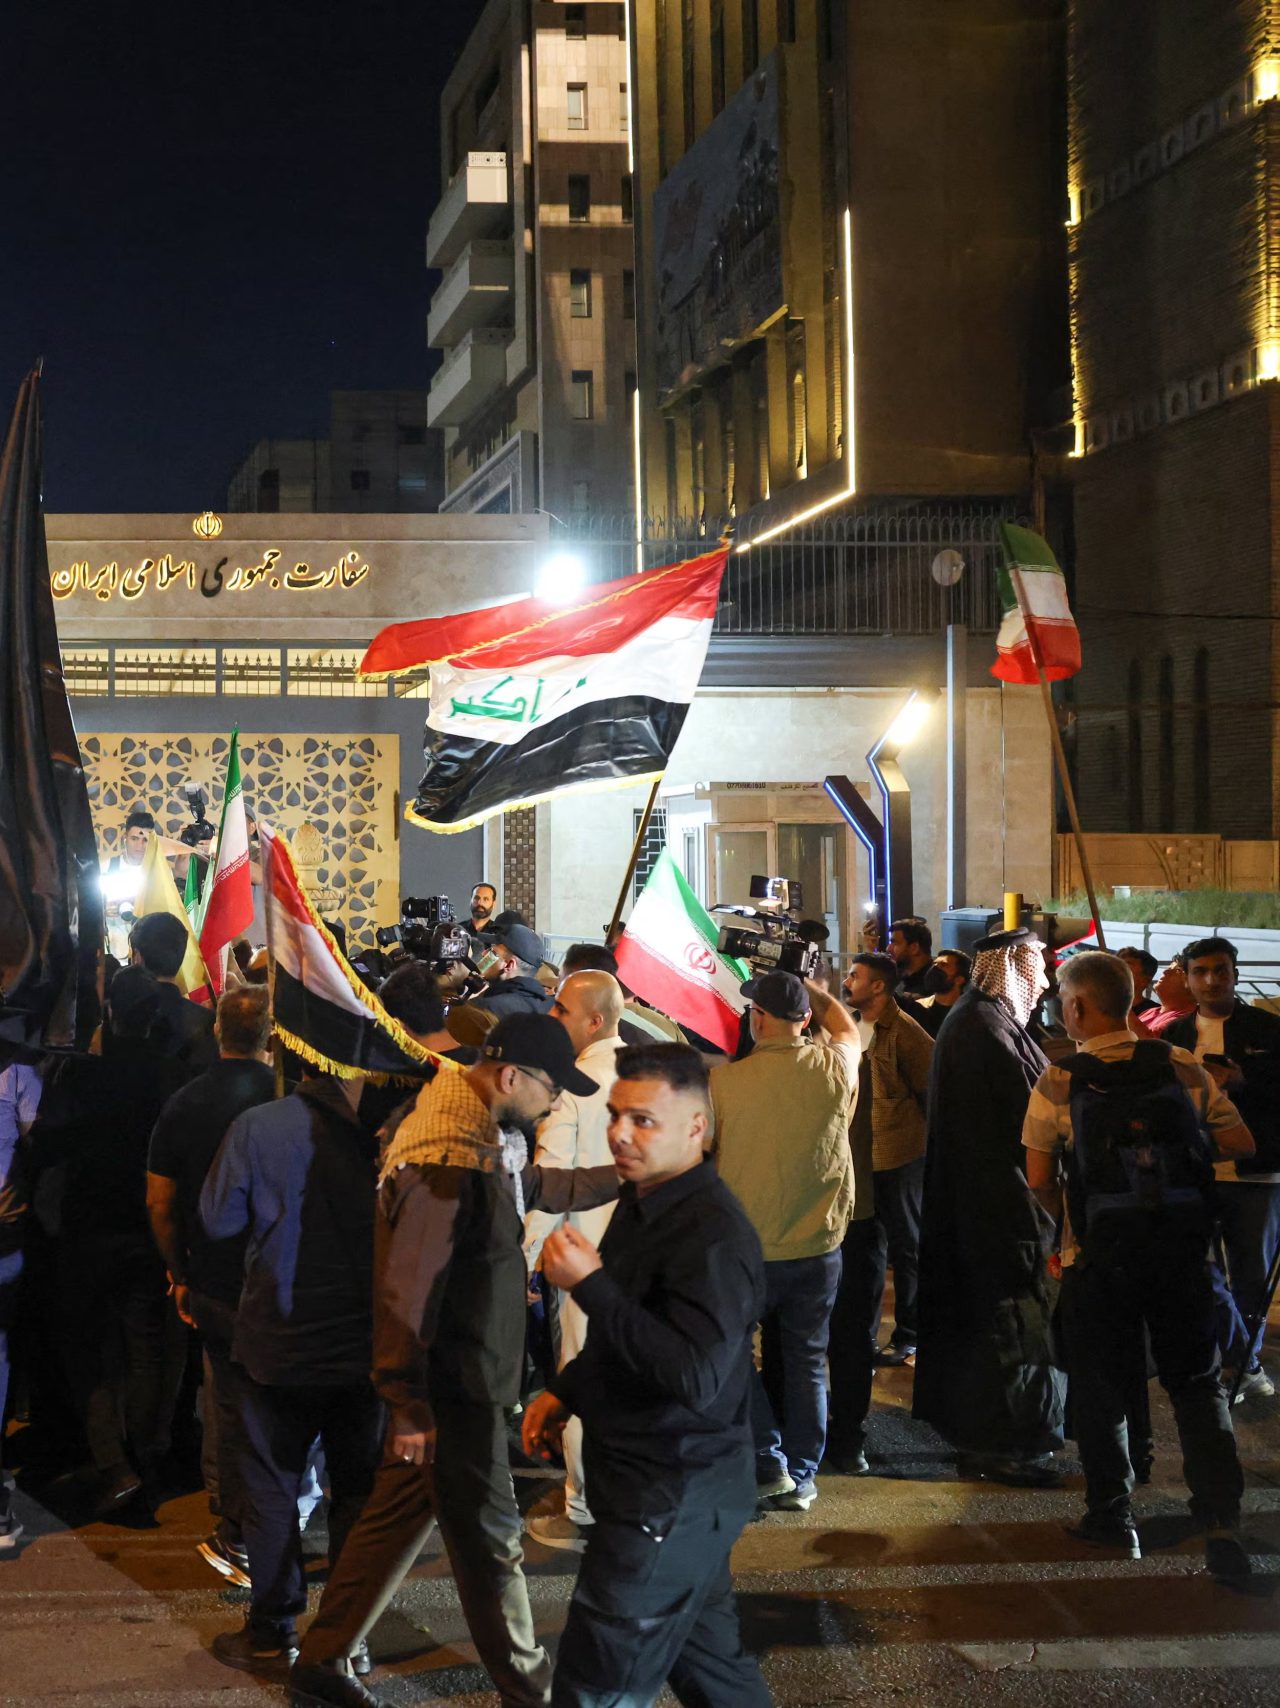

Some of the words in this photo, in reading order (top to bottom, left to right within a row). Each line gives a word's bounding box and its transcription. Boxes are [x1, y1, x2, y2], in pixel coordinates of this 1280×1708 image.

[50, 560, 118, 601] ایران
[120, 553, 195, 601] اسلامی
[200, 548, 281, 598] جمهوری
[285, 551, 369, 591] سفارت
